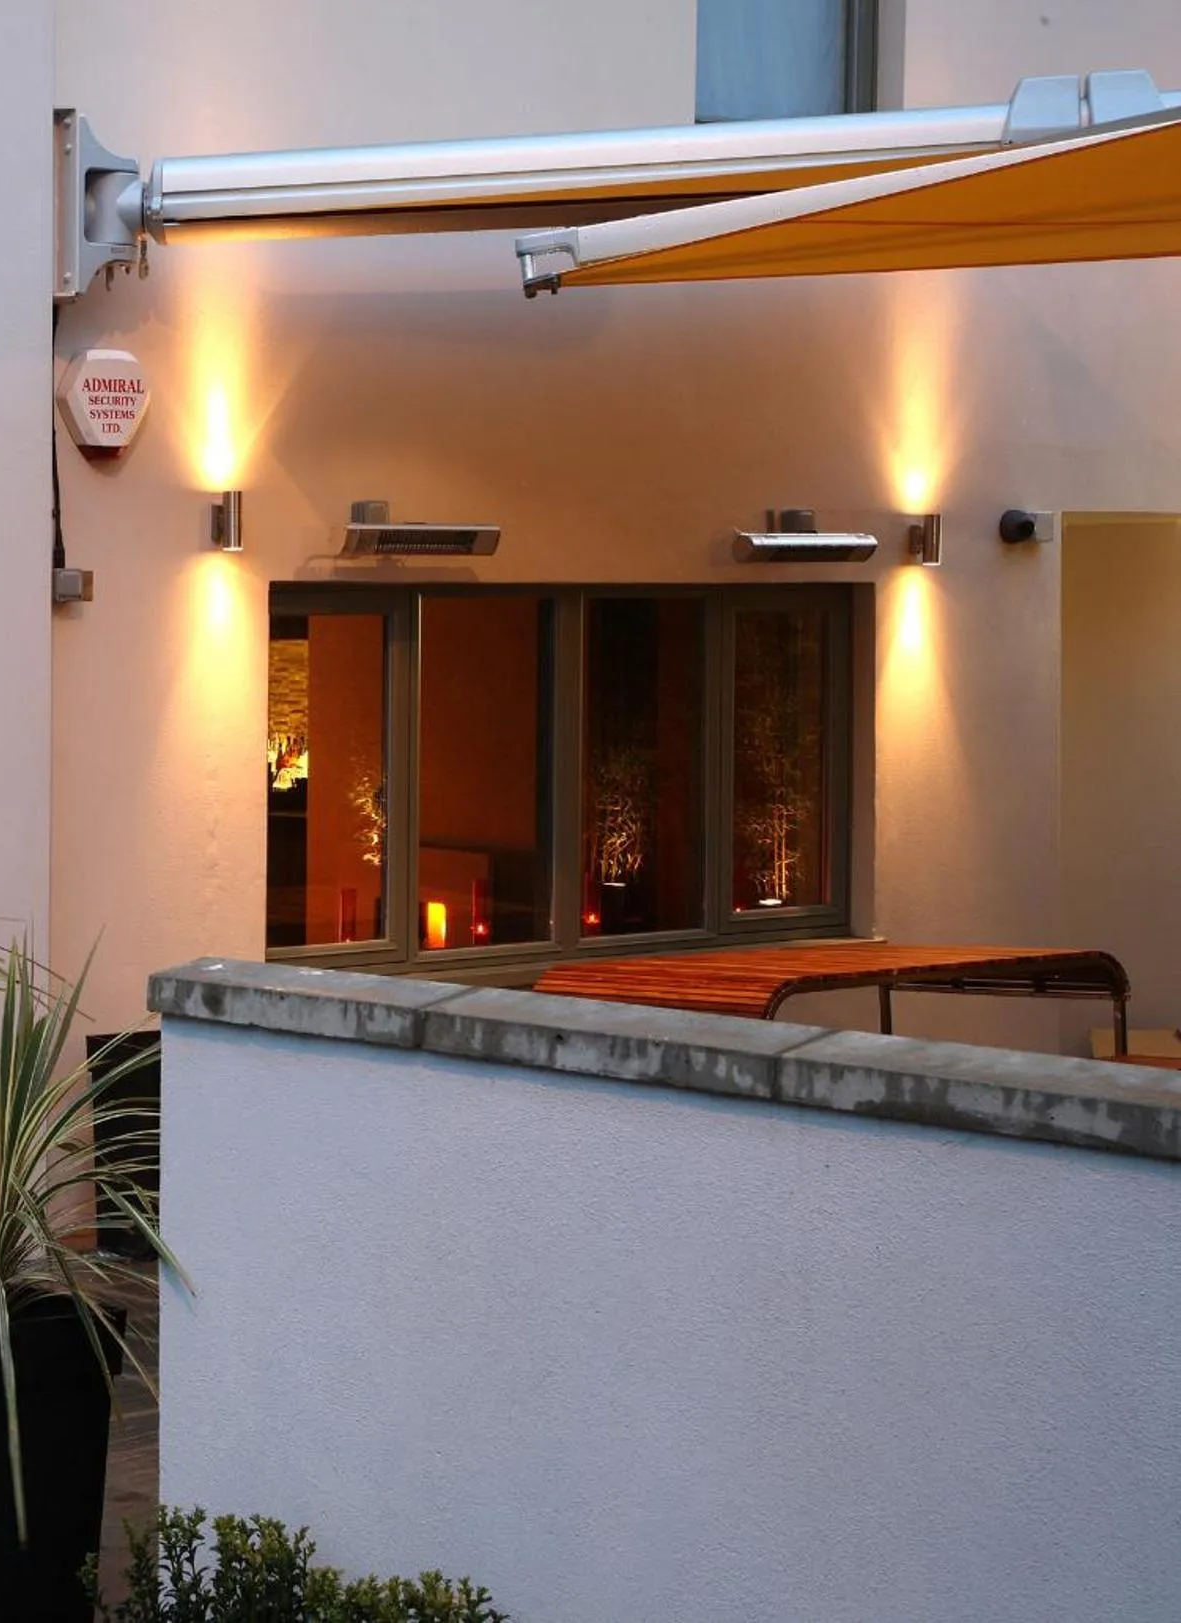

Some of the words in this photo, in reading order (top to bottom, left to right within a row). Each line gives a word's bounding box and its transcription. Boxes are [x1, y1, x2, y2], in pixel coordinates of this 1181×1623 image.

[82, 378, 145, 394] ADMIRAL
[88, 396, 137, 406] SECURITY
[89, 409, 135, 419] SYSTEMS
[102, 423, 123, 434] LTD.
